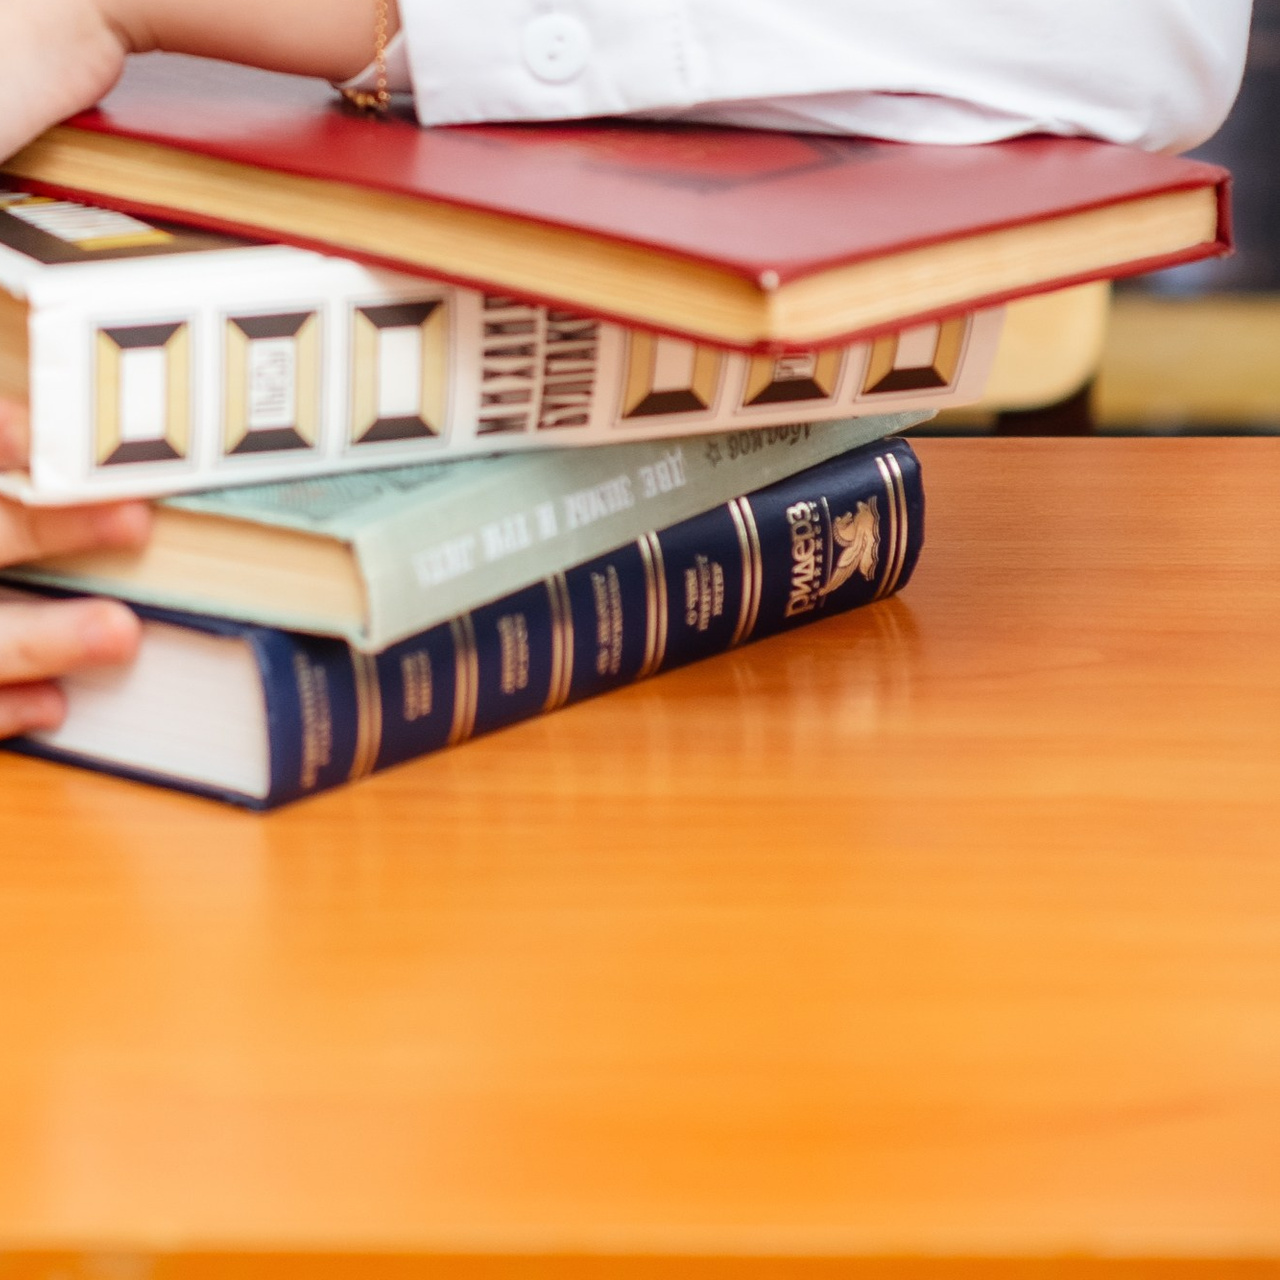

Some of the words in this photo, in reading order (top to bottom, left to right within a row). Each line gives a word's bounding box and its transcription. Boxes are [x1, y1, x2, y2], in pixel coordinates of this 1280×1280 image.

[639, 446, 687, 499] ДВЕ
[536, 500, 558, 540] И
[565, 474, 636, 530] ЗИМЫ
